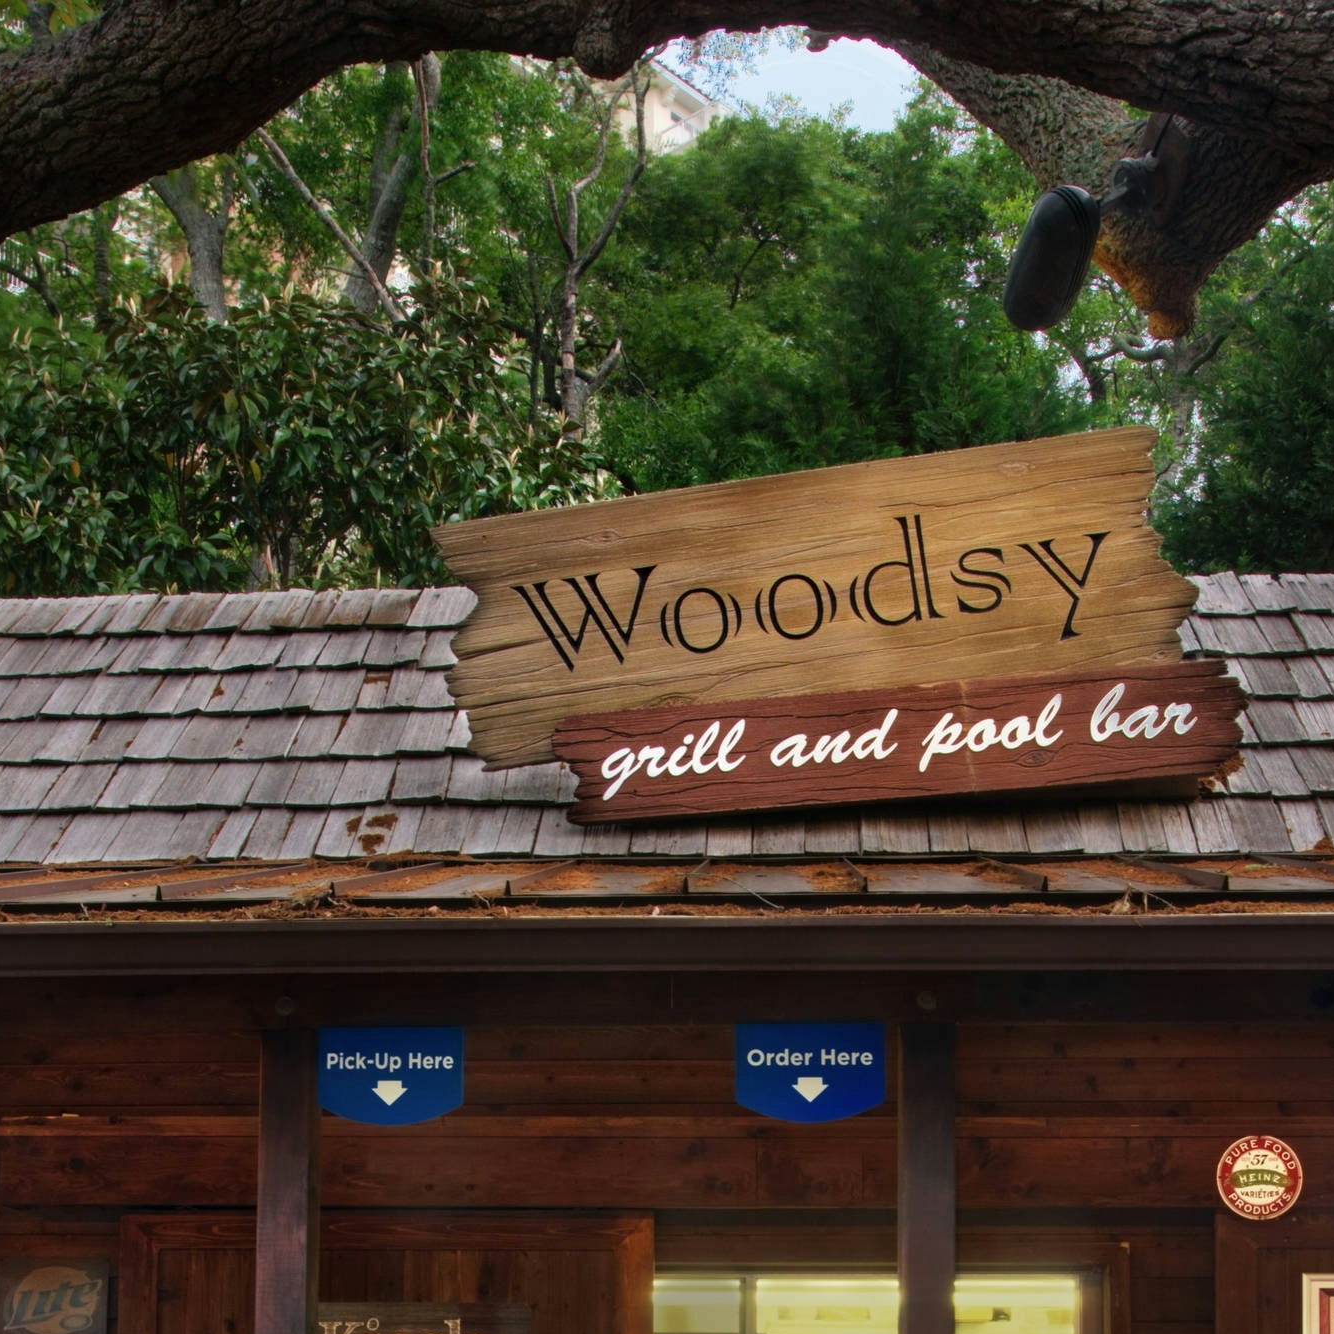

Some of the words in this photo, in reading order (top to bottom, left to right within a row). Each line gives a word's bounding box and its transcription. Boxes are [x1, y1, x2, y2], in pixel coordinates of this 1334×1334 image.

[510, 514, 1111, 672] Woodsy
[600, 719, 747, 800] grill
[770, 708, 898, 769] and
[918, 694, 1063, 773] pool
[1089, 683, 1198, 743] bar
[326, 1052, 402, 1073] Pick-Up
[408, 1052, 454, 1069] Here
[747, 1048, 813, 1066] Order
[820, 1048, 874, 1066] Here
[1225, 1139, 1259, 1165] PURE
[1263, 1140, 1296, 1170] FOOD
[1250, 1154, 1269, 1166] 57
[1238, 1173, 1281, 1183] HEINZ
[1228, 1192, 1291, 1215] PRODUCTS
[5, 1280, 102, 1330] Lite
